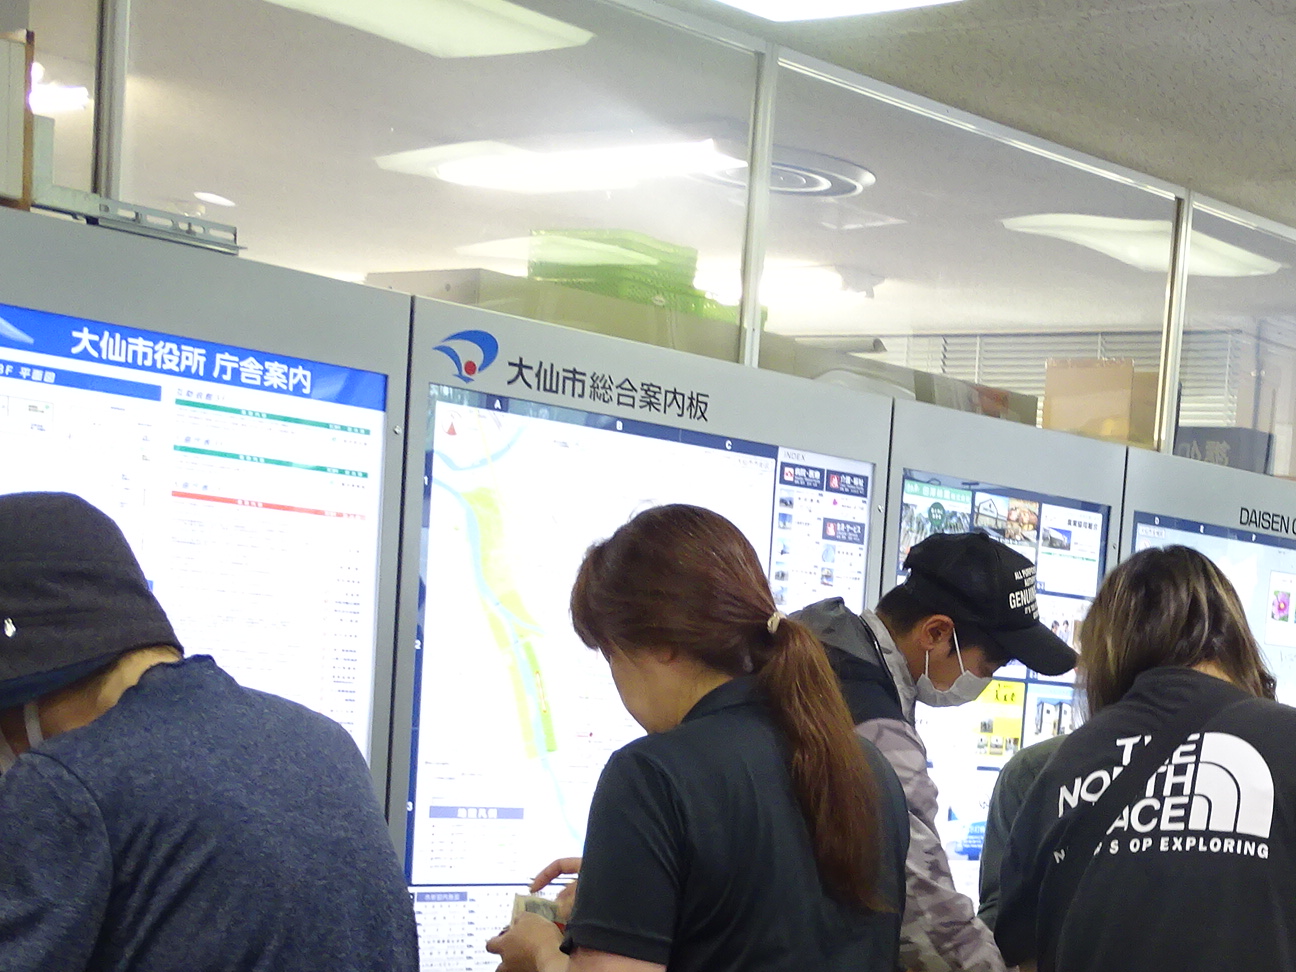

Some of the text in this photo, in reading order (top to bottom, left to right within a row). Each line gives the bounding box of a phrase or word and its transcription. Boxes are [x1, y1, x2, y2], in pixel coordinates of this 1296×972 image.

[71, 327, 312, 394] 大仙市役所 庁舎案内
[507, 356, 710, 422] 大仙市総合案内板
[494, 399, 502, 409] A
[616, 420, 623, 431] B
[725, 440, 732, 450] C
[424, 475, 429, 485] 1
[1239, 507, 1290, 534] DAISEN
[414, 640, 421, 650] 2
[1116, 733, 1200, 767] TE
[1058, 763, 1196, 818] NOTH
[406, 801, 413, 811] 3
[1104, 796, 1190, 836] ACE
[1160, 836, 1269, 859] EXPLORING
